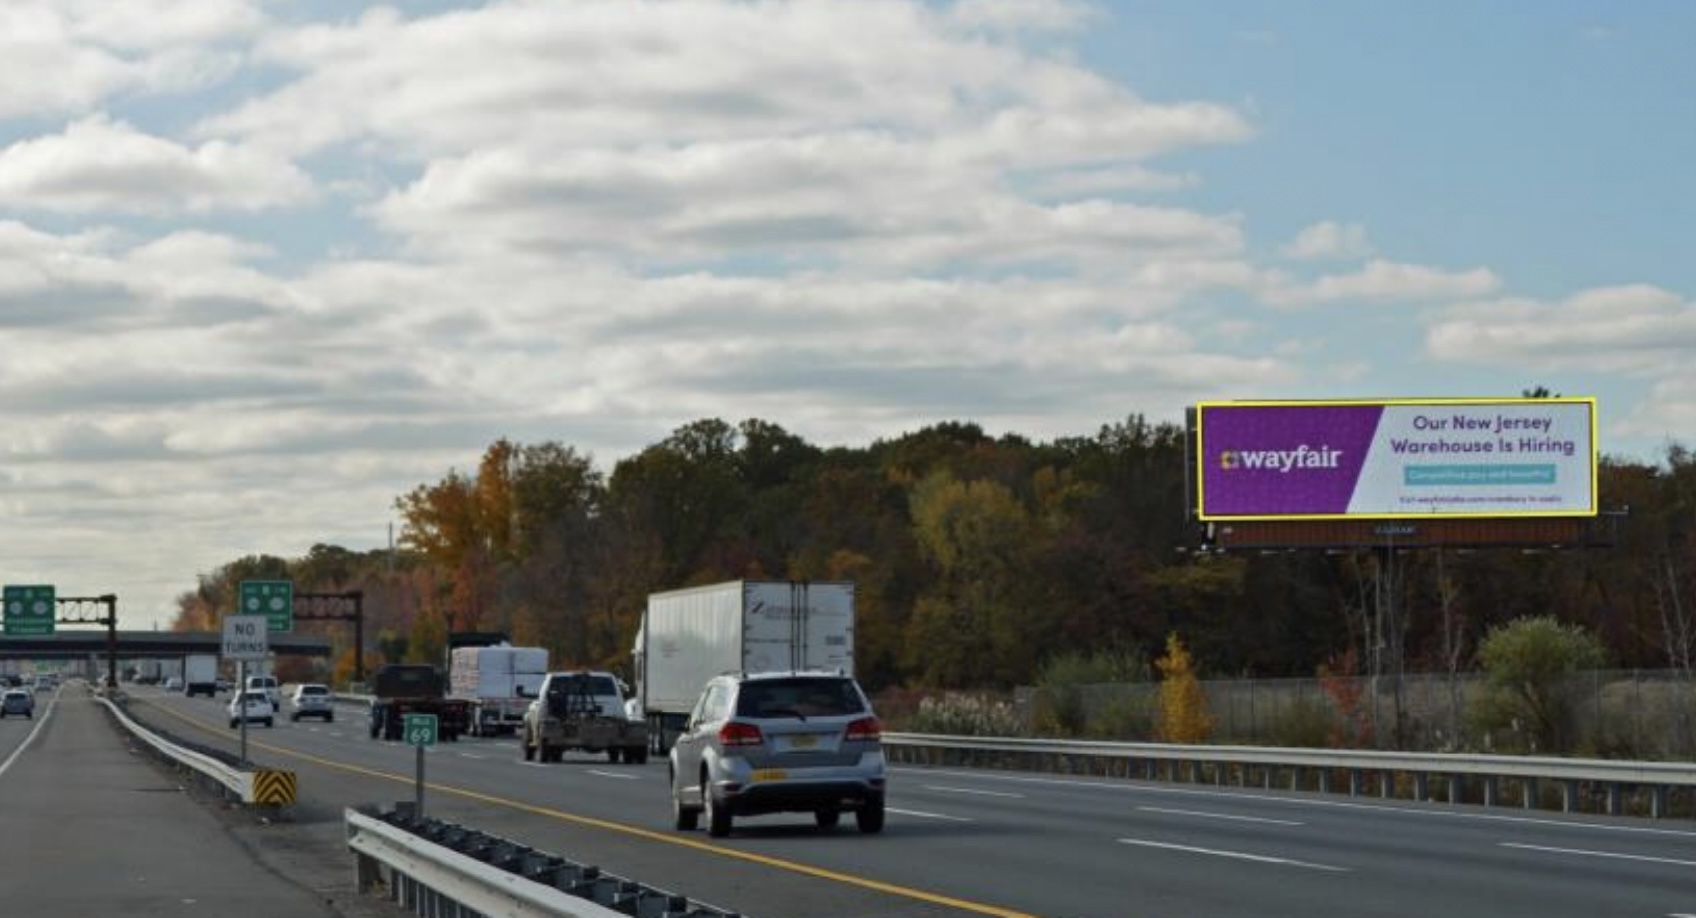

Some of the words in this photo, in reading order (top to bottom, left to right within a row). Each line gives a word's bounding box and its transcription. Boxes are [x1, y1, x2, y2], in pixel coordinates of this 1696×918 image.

[1413, 415, 1448, 430] Our
[1453, 415, 1491, 429] New
[1495, 415, 1552, 433] Jersey
[1390, 438, 1494, 454] Warehouse
[1499, 438, 1513, 452] Is
[1519, 437, 1575, 456] Hiring
[1241, 445, 1342, 473] wayfair
[235, 622, 255, 636] NO
[225, 641, 264, 653] TURNS
[410, 728, 430, 742] 69
